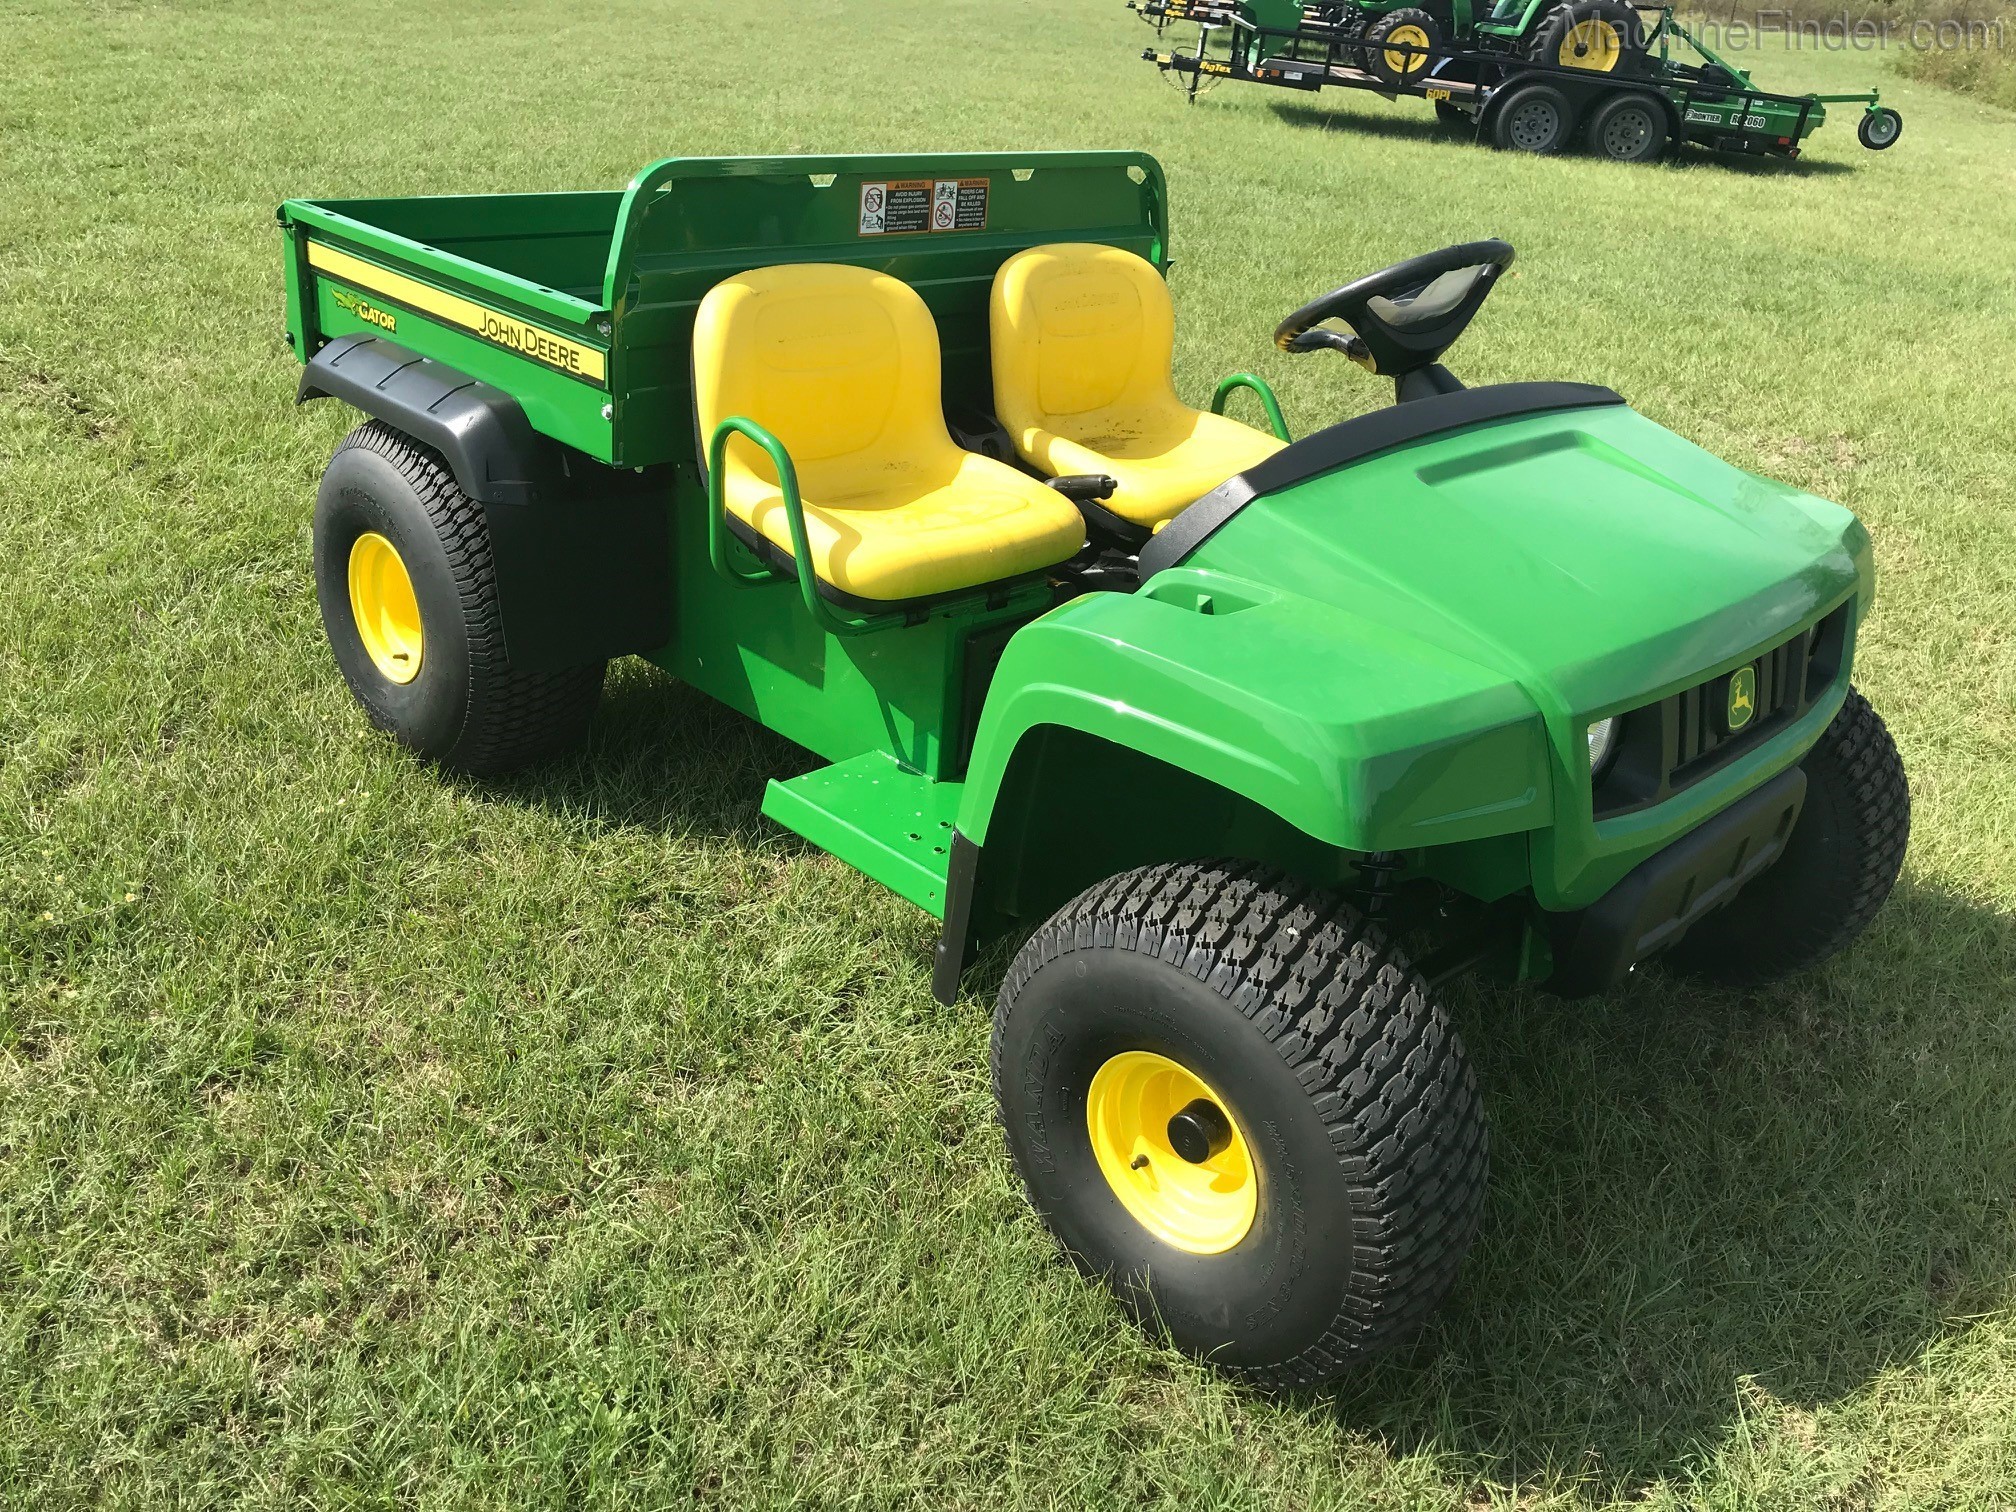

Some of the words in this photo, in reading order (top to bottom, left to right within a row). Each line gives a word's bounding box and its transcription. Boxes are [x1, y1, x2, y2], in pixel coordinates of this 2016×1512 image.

[1199, 61, 1232, 73] BigTex
[358, 301, 396, 332] GATOR
[478, 312, 521, 347] JOHN
[525, 328, 580, 370] DEERE
[1025, 1022, 1066, 1174] WANDA
